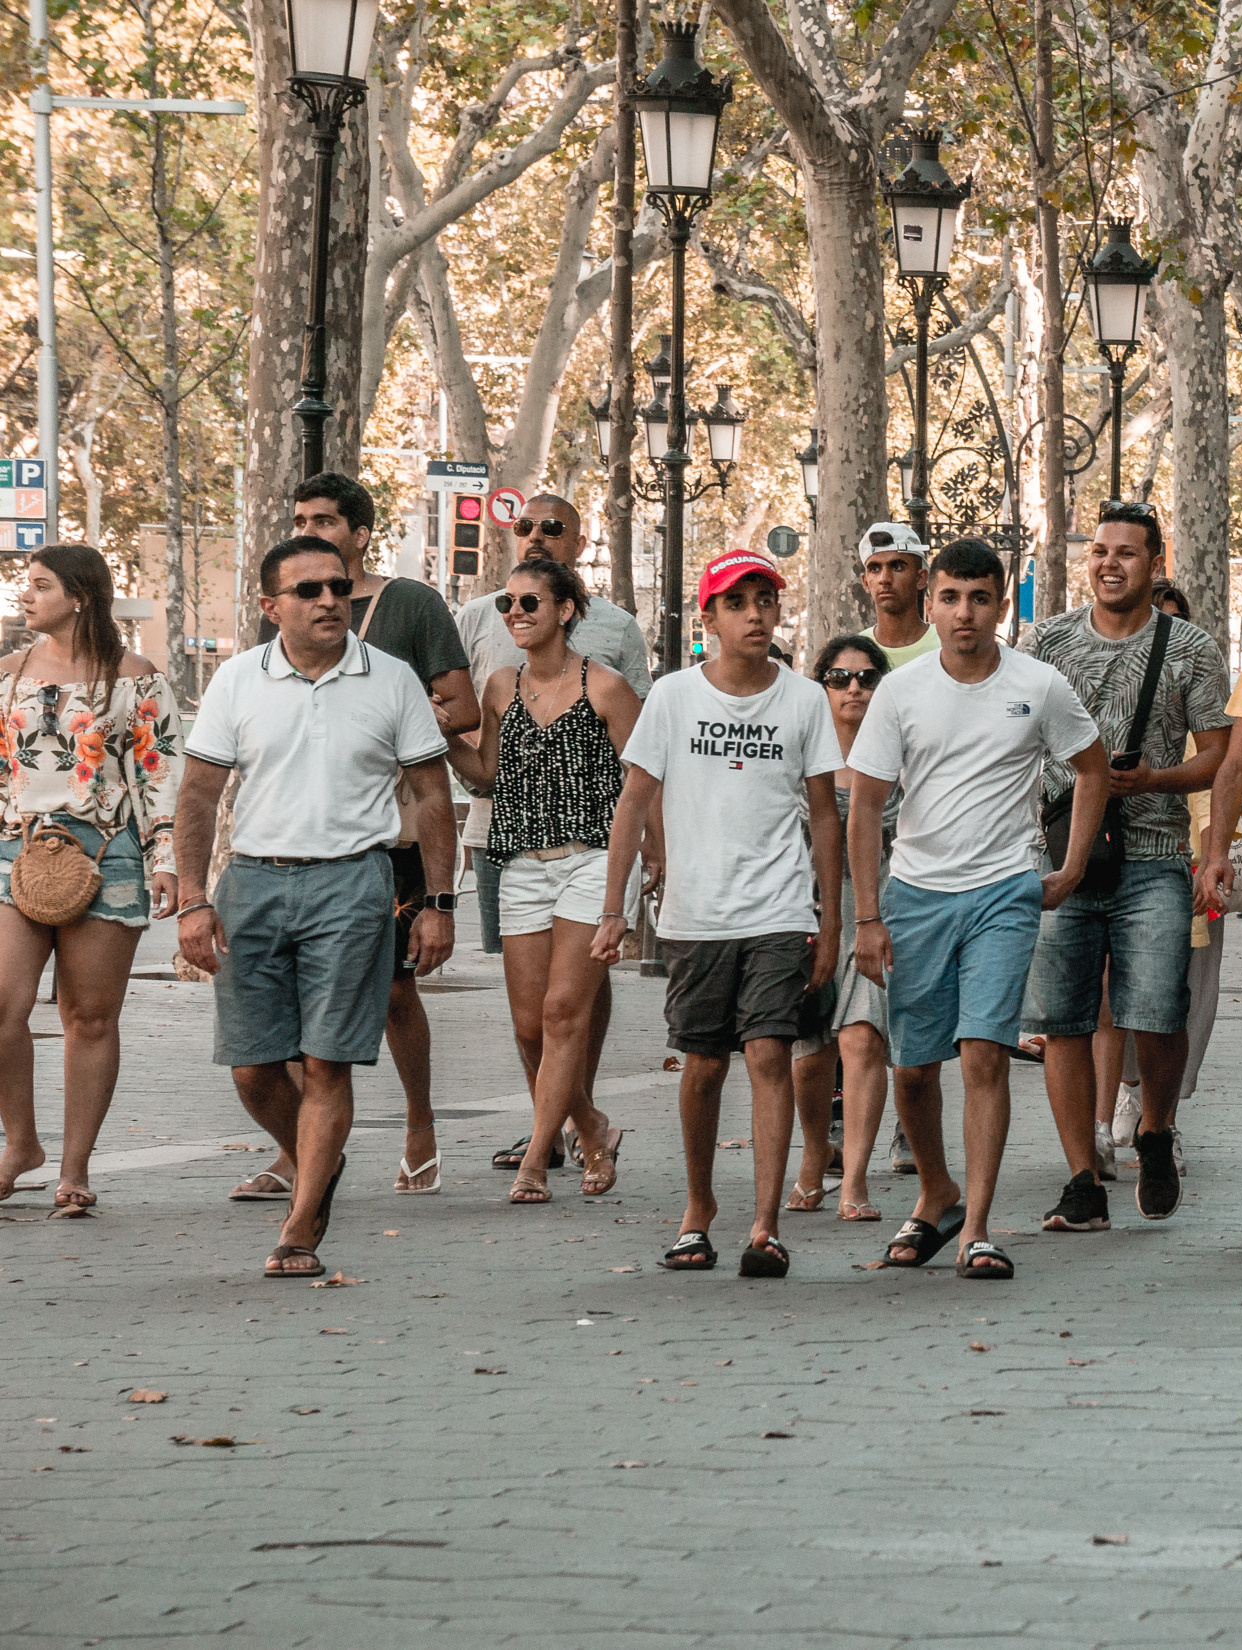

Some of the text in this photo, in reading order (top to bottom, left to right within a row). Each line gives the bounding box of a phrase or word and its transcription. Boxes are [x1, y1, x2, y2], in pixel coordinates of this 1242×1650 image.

[22, 463, 41, 485] P
[697, 720, 779, 741] TOMMY
[690, 738, 784, 760] HILFIGER
